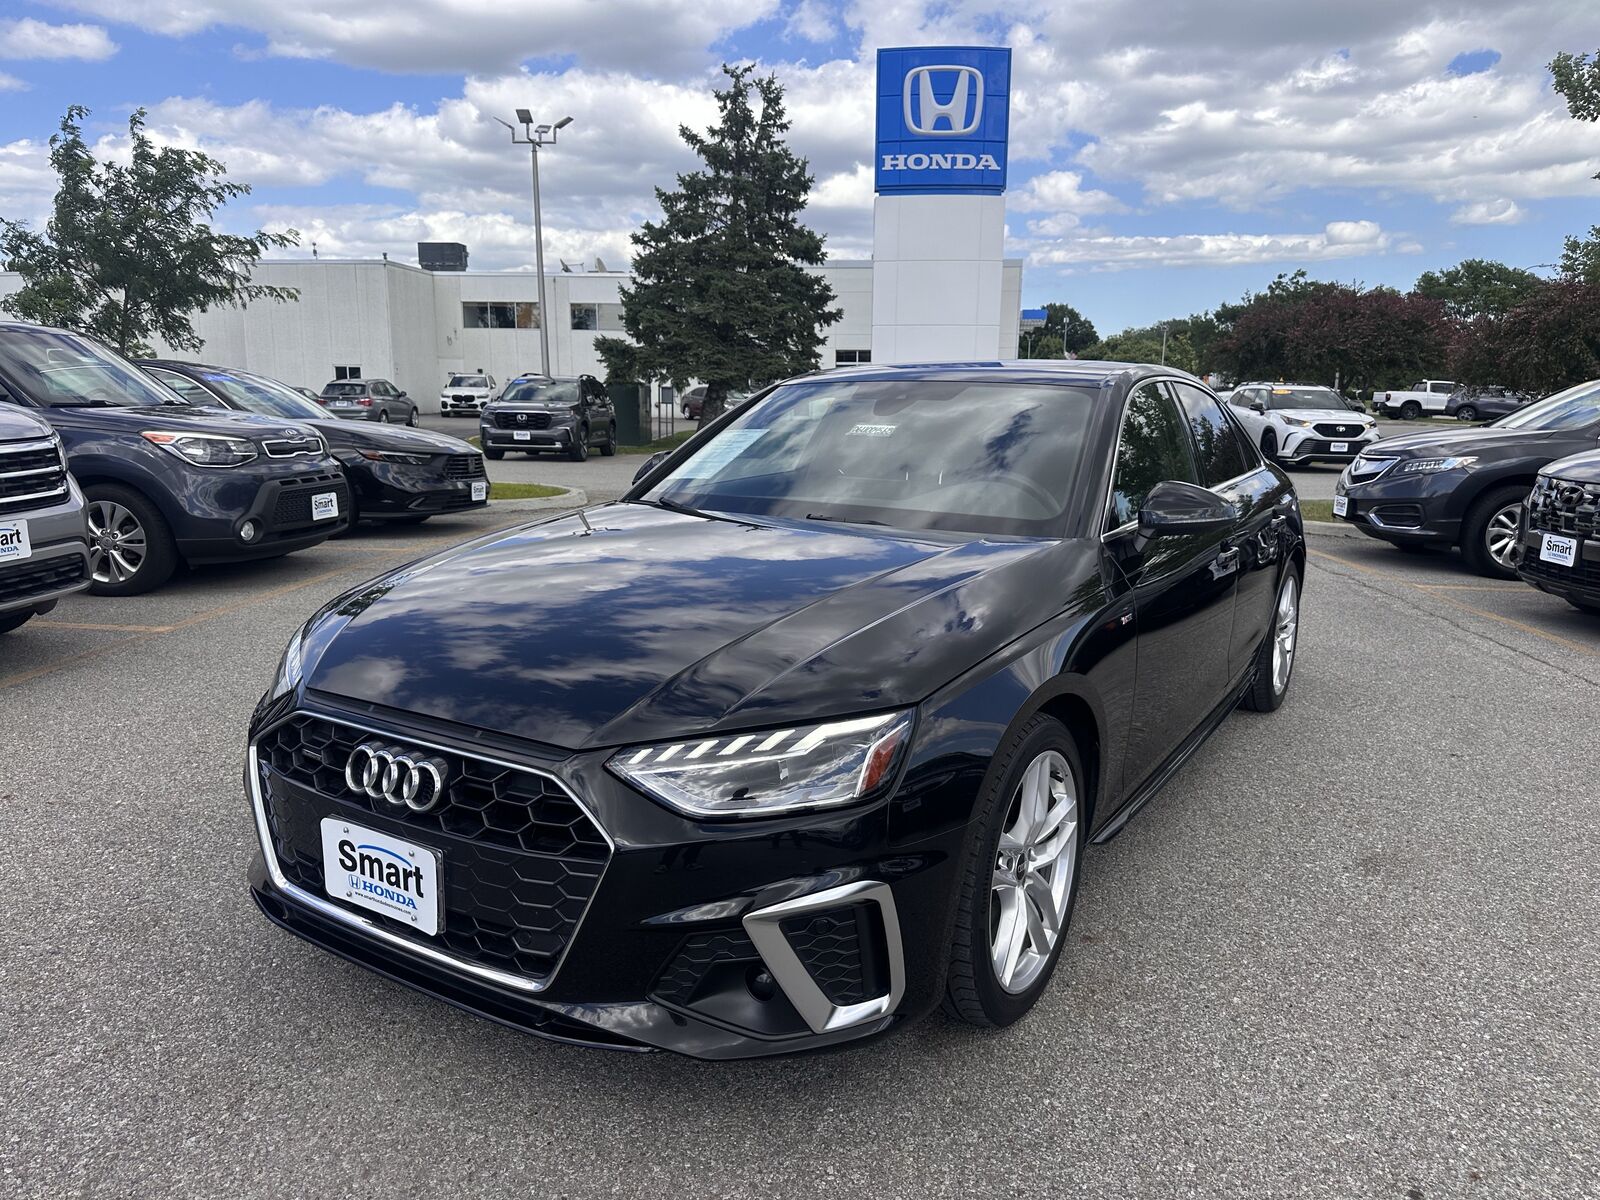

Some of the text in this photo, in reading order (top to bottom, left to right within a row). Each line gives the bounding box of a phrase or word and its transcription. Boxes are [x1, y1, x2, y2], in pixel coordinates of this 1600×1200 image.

[882, 153, 1001, 171] HONDA
[314, 498, 334, 510] Smart
[0, 528, 22, 546] art
[0, 545, 19, 553] NDA
[1546, 539, 1572, 555] Smart
[338, 839, 424, 898] Smart
[362, 879, 418, 910] HONDA
